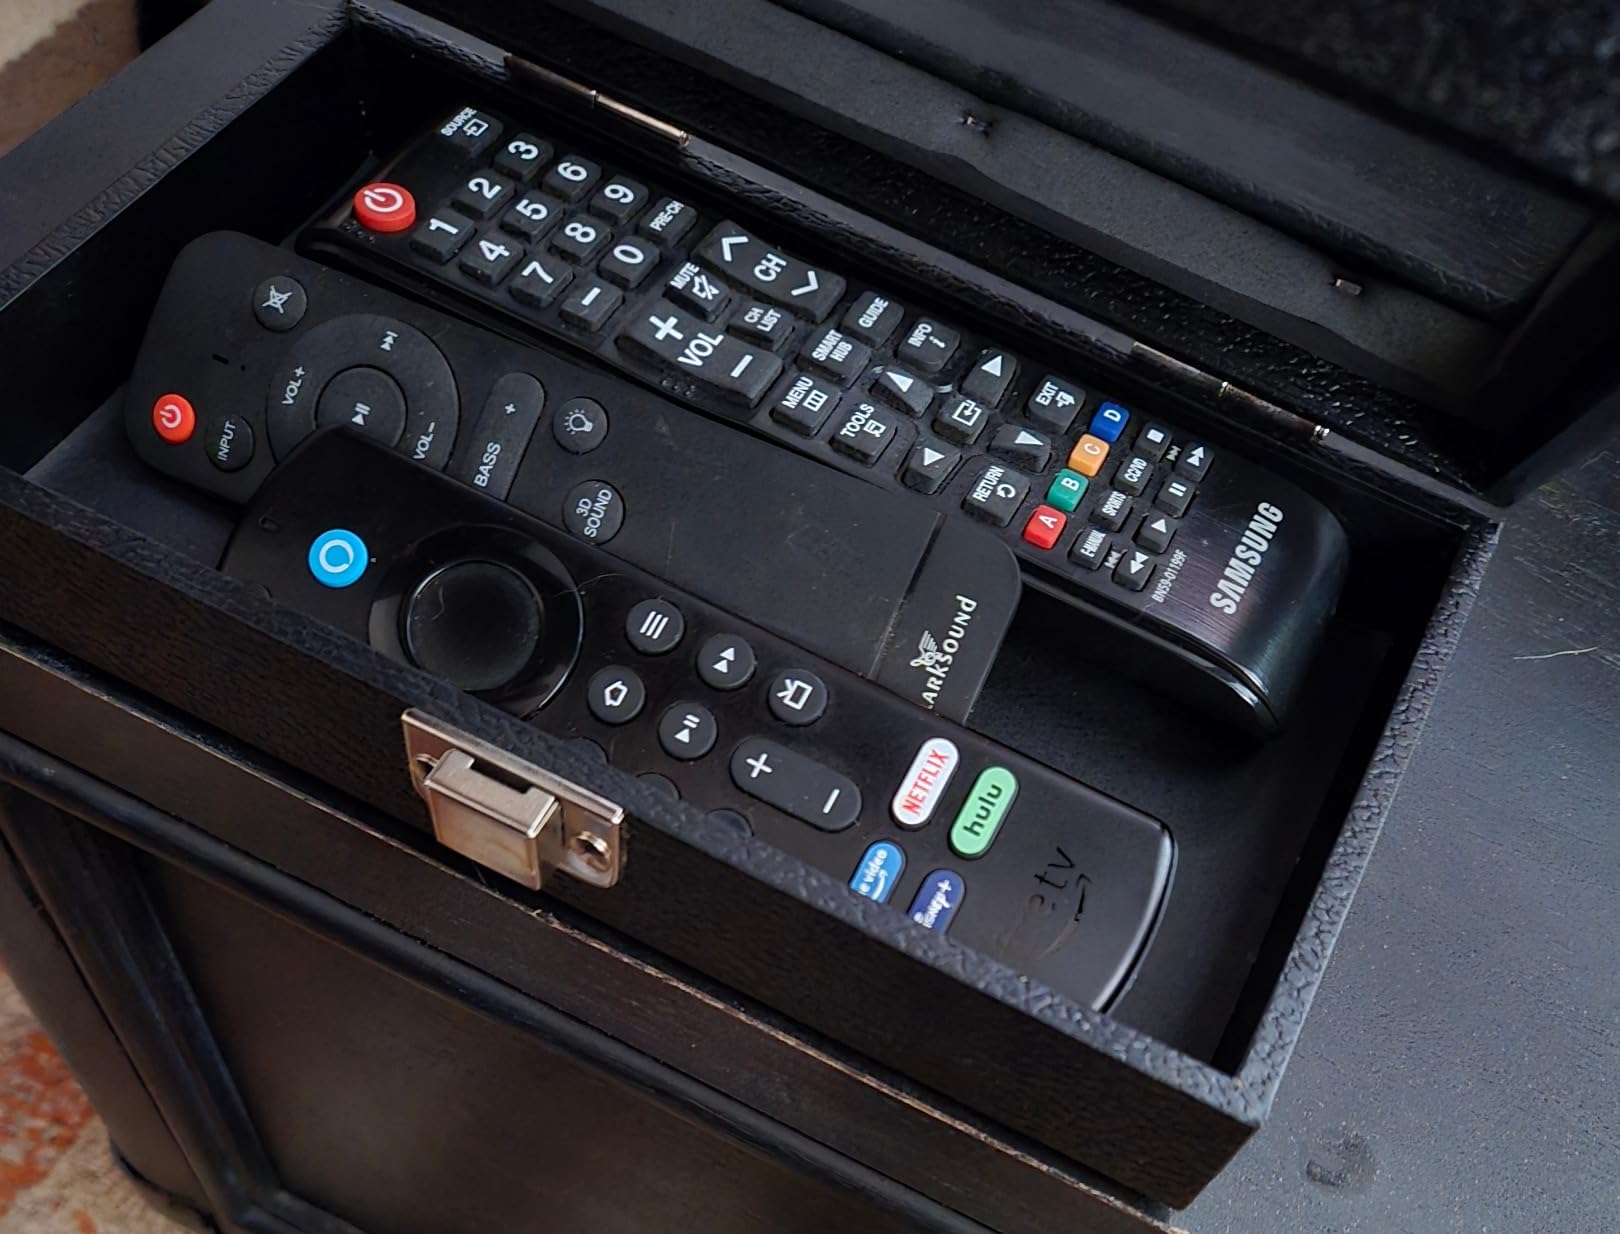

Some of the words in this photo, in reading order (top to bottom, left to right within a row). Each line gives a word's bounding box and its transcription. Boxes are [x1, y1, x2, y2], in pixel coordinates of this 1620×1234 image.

[440, 106, 477, 137] SOURCE
[507, 140, 539, 160] 3
[557, 161, 588, 182] 6
[467, 177, 502, 199] 2
[603, 184, 634, 204] 9
[515, 198, 548, 221] 5
[649, 200, 685, 232] PRE-CH
[428, 217, 459, 235] 1
[564, 222, 596, 243] 8
[478, 239, 510, 262] 4
[612, 244, 645, 264] 0
[521, 260, 554, 284] 7
[669, 261, 700, 290] MUTE
[753, 252, 787, 282] CH
[743, 307, 764, 324] CH
[757, 308, 782, 333] LIST
[858, 296, 889, 329] GUIDE
[811, 329, 843, 362] SMART
[907, 322, 933, 348] INFO
[677, 332, 724, 367] VOL
[829, 341, 853, 363] HUB
[781, 376, 814, 409] MENU
[1035, 381, 1059, 406] EXIT
[840, 403, 875, 438] TOOLS
[1103, 408, 1122, 423] D
[216, 420, 237, 462] INPUT
[1083, 443, 1101, 455] C
[473, 442, 501, 488] BASS
[1124, 457, 1148, 483] CC/VD
[972, 465, 1005, 503] RETURN
[1061, 477, 1080, 492] B
[575, 497, 593, 518] 3D
[583, 489, 613, 538] SOUND
[1101, 491, 1127, 517] SPORTS
[1038, 513, 1059, 529] A
[1209, 501, 1284, 615] SAMSUNG
[902, 749, 950, 817] NETFLIX
[962, 783, 1003, 837] hulu
[863, 848, 889, 883] video
